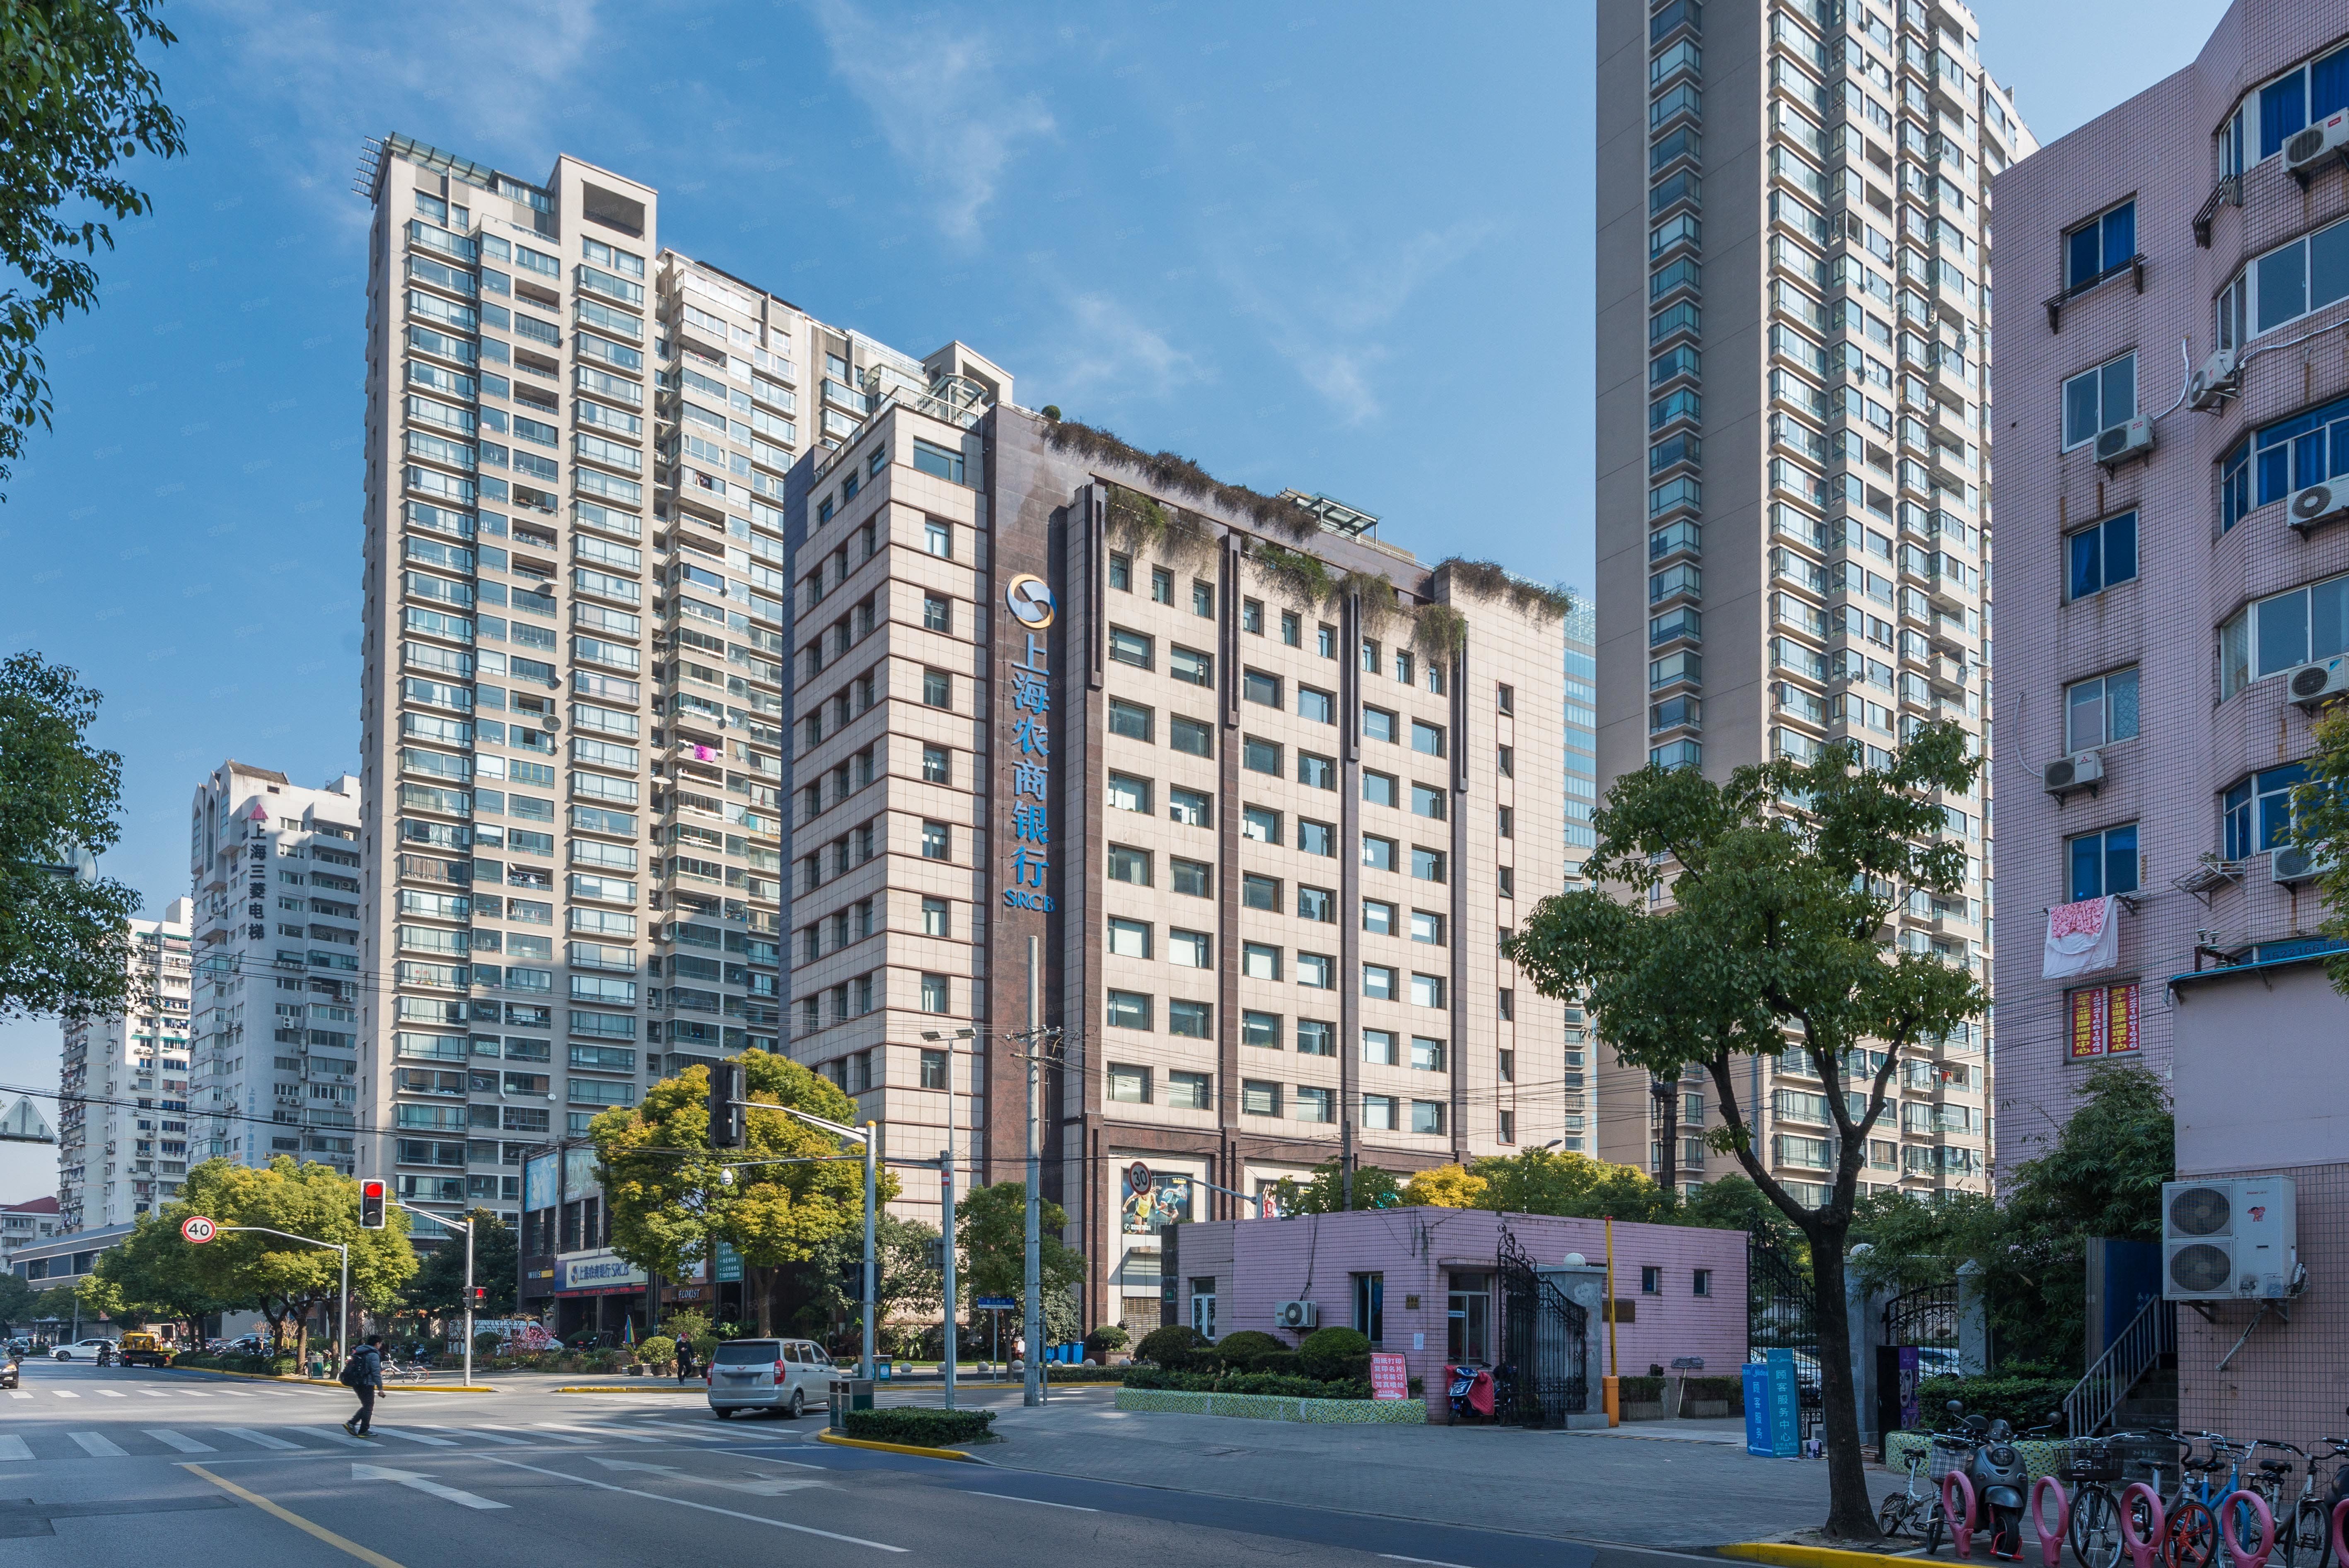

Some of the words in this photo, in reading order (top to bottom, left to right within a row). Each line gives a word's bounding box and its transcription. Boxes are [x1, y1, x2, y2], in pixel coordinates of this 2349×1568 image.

[1011, 633, 1050, 887] 上海农商银行
[249, 823, 266, 940] 上海三菱电梯
[1004, 888, 1055, 913] SRCB
[2093, 991, 2101, 1052] 15221661646
[2129, 986, 2138, 1048] 15221661646
[1133, 1170, 1148, 1187] 30
[188, 1223, 210, 1236] 40
[611, 1262, 629, 1277] SRCB
[679, 1288, 701, 1299] FLORIST
[1753, 1382, 1762, 1439] 顾客服务
[1776, 1370, 1791, 1442] 顾客服务中心
